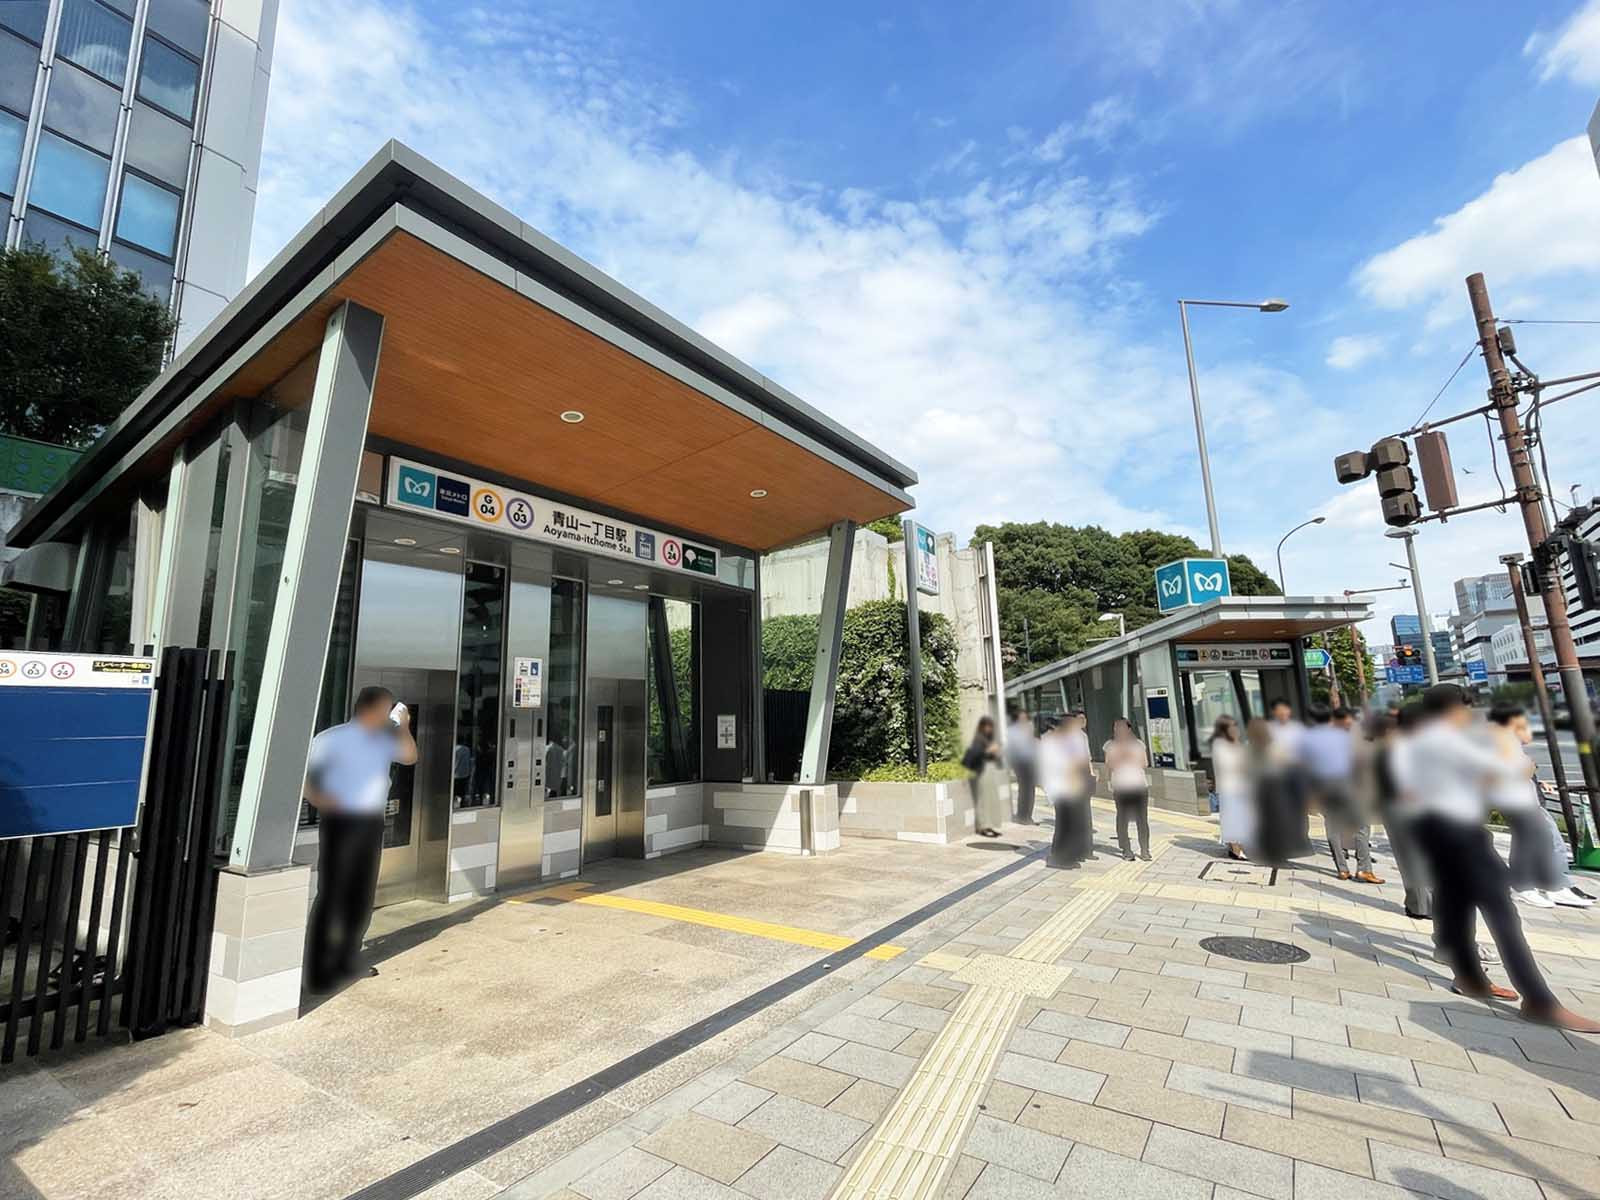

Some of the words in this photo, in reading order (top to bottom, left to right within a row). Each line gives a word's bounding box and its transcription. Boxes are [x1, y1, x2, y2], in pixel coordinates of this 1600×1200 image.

[484, 494, 493, 504] G
[480, 504, 495, 516] 04
[517, 503, 524, 512] Z
[513, 514, 527, 524] 03
[552, 510, 627, 543] 青山一丁目駅
[543, 525, 617, 551] Aoyama-itchome
[618, 543, 634, 555] Sta.
